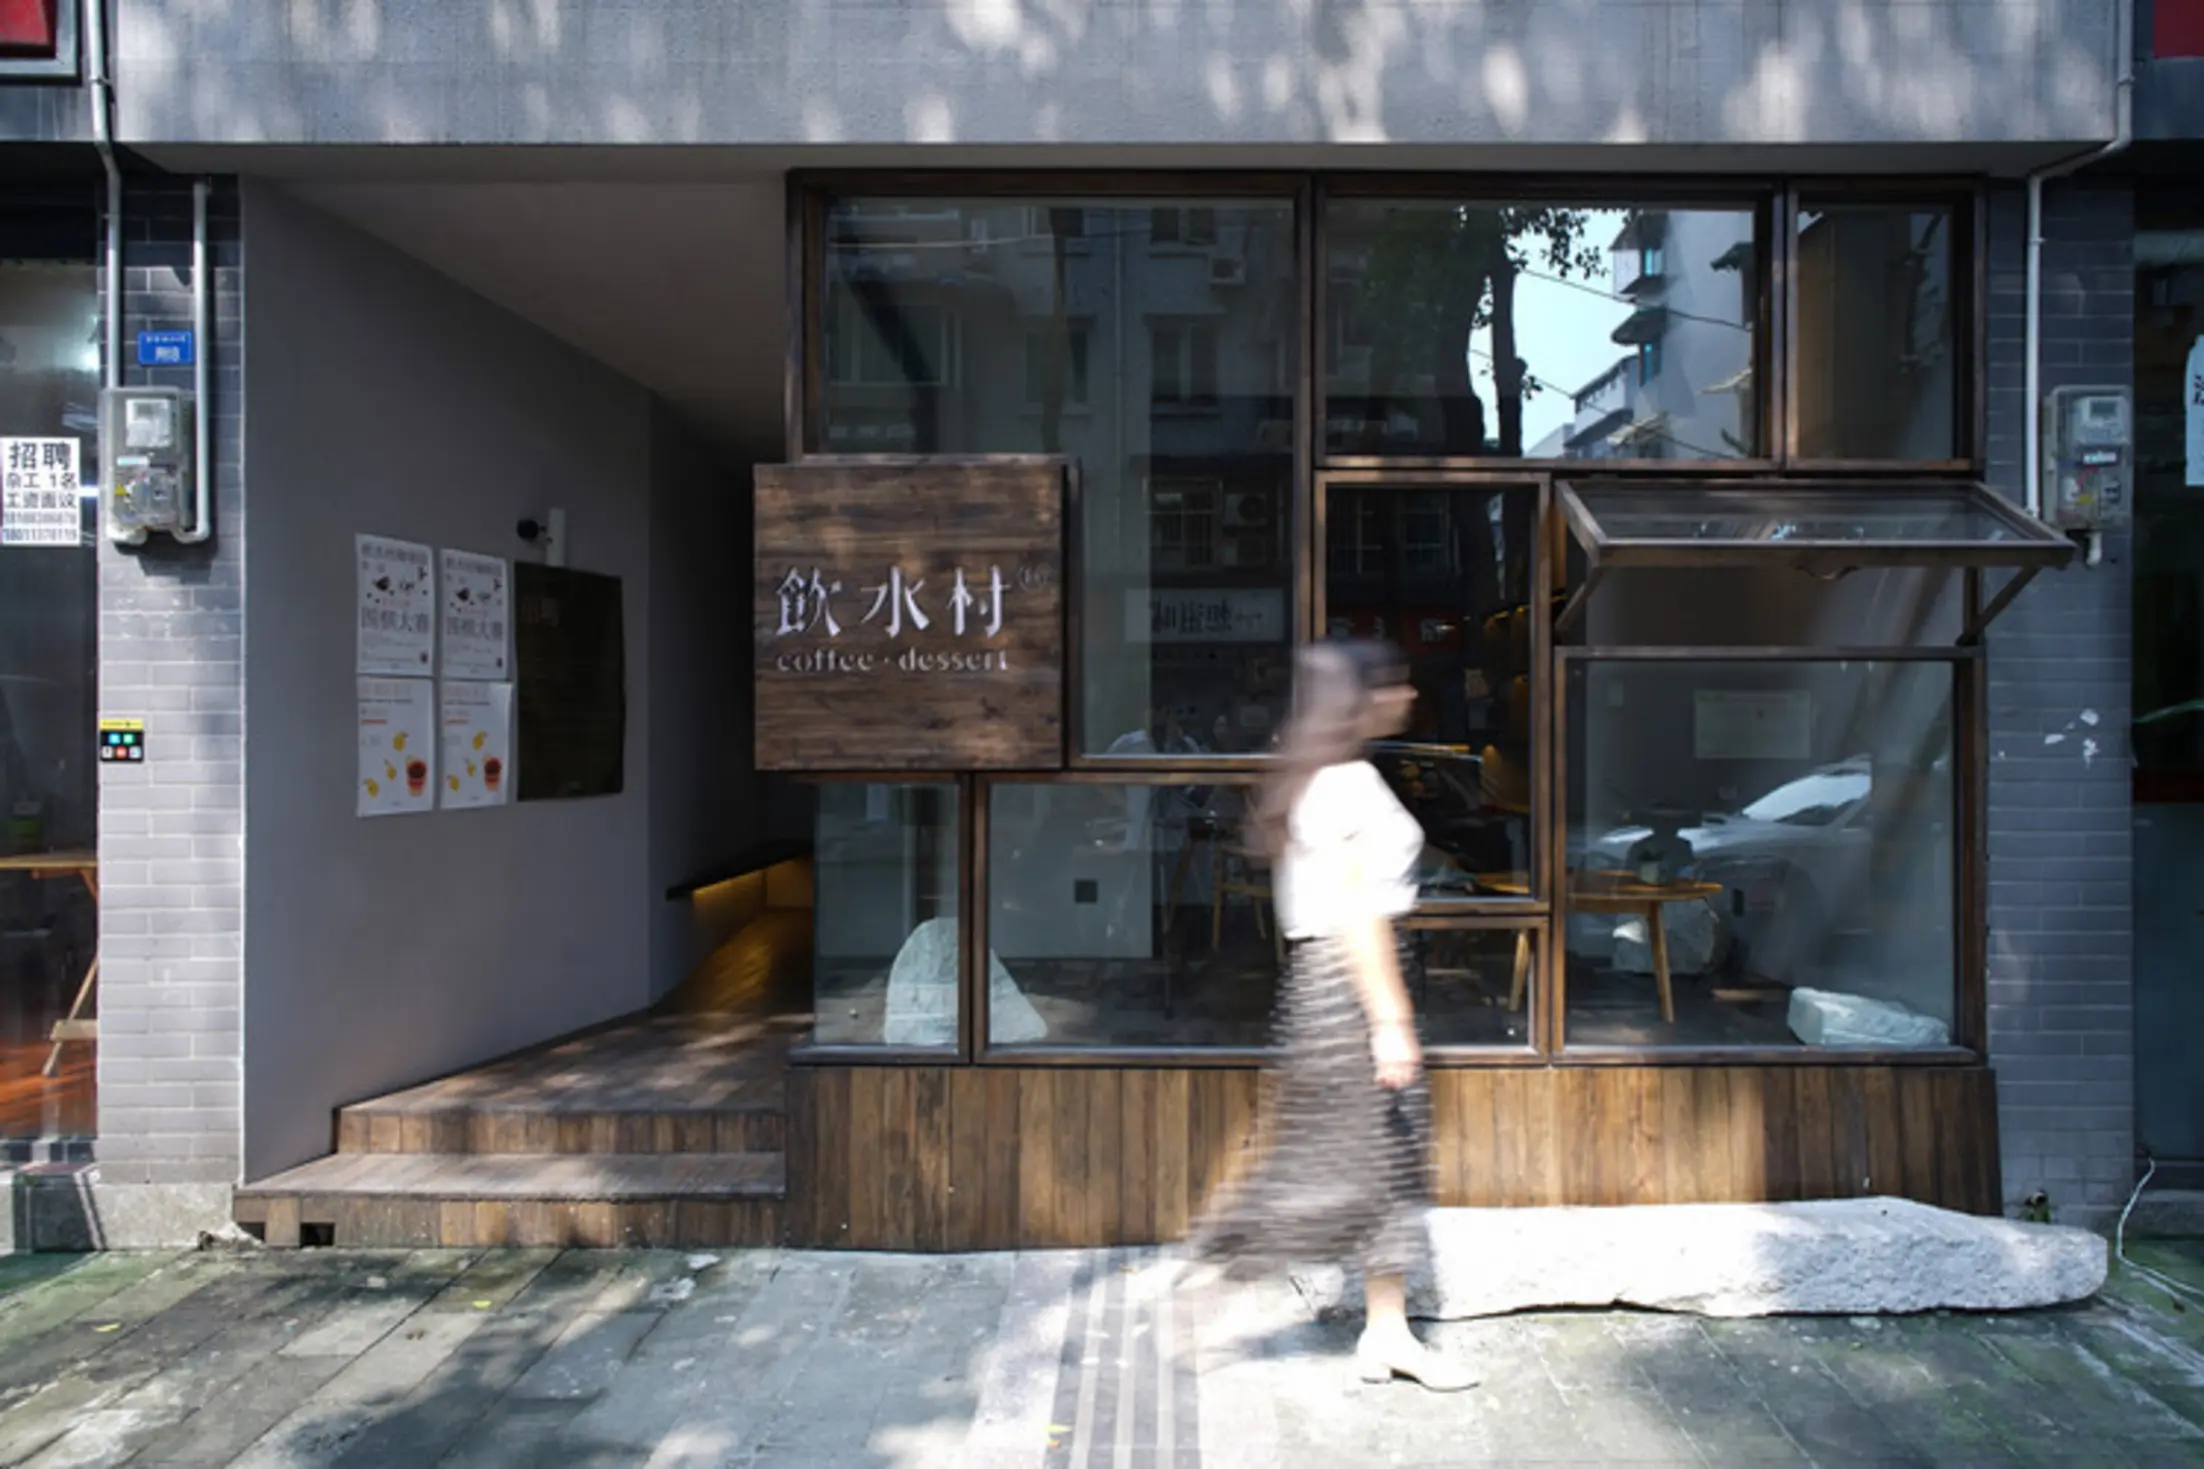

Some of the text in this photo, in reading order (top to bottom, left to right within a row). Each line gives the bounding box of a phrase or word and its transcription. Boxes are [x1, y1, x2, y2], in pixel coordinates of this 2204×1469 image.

[8, 441, 71, 470] 招聘
[775, 564, 1011, 638] 飲水村
[776, 647, 1007, 672] coffee dessert
